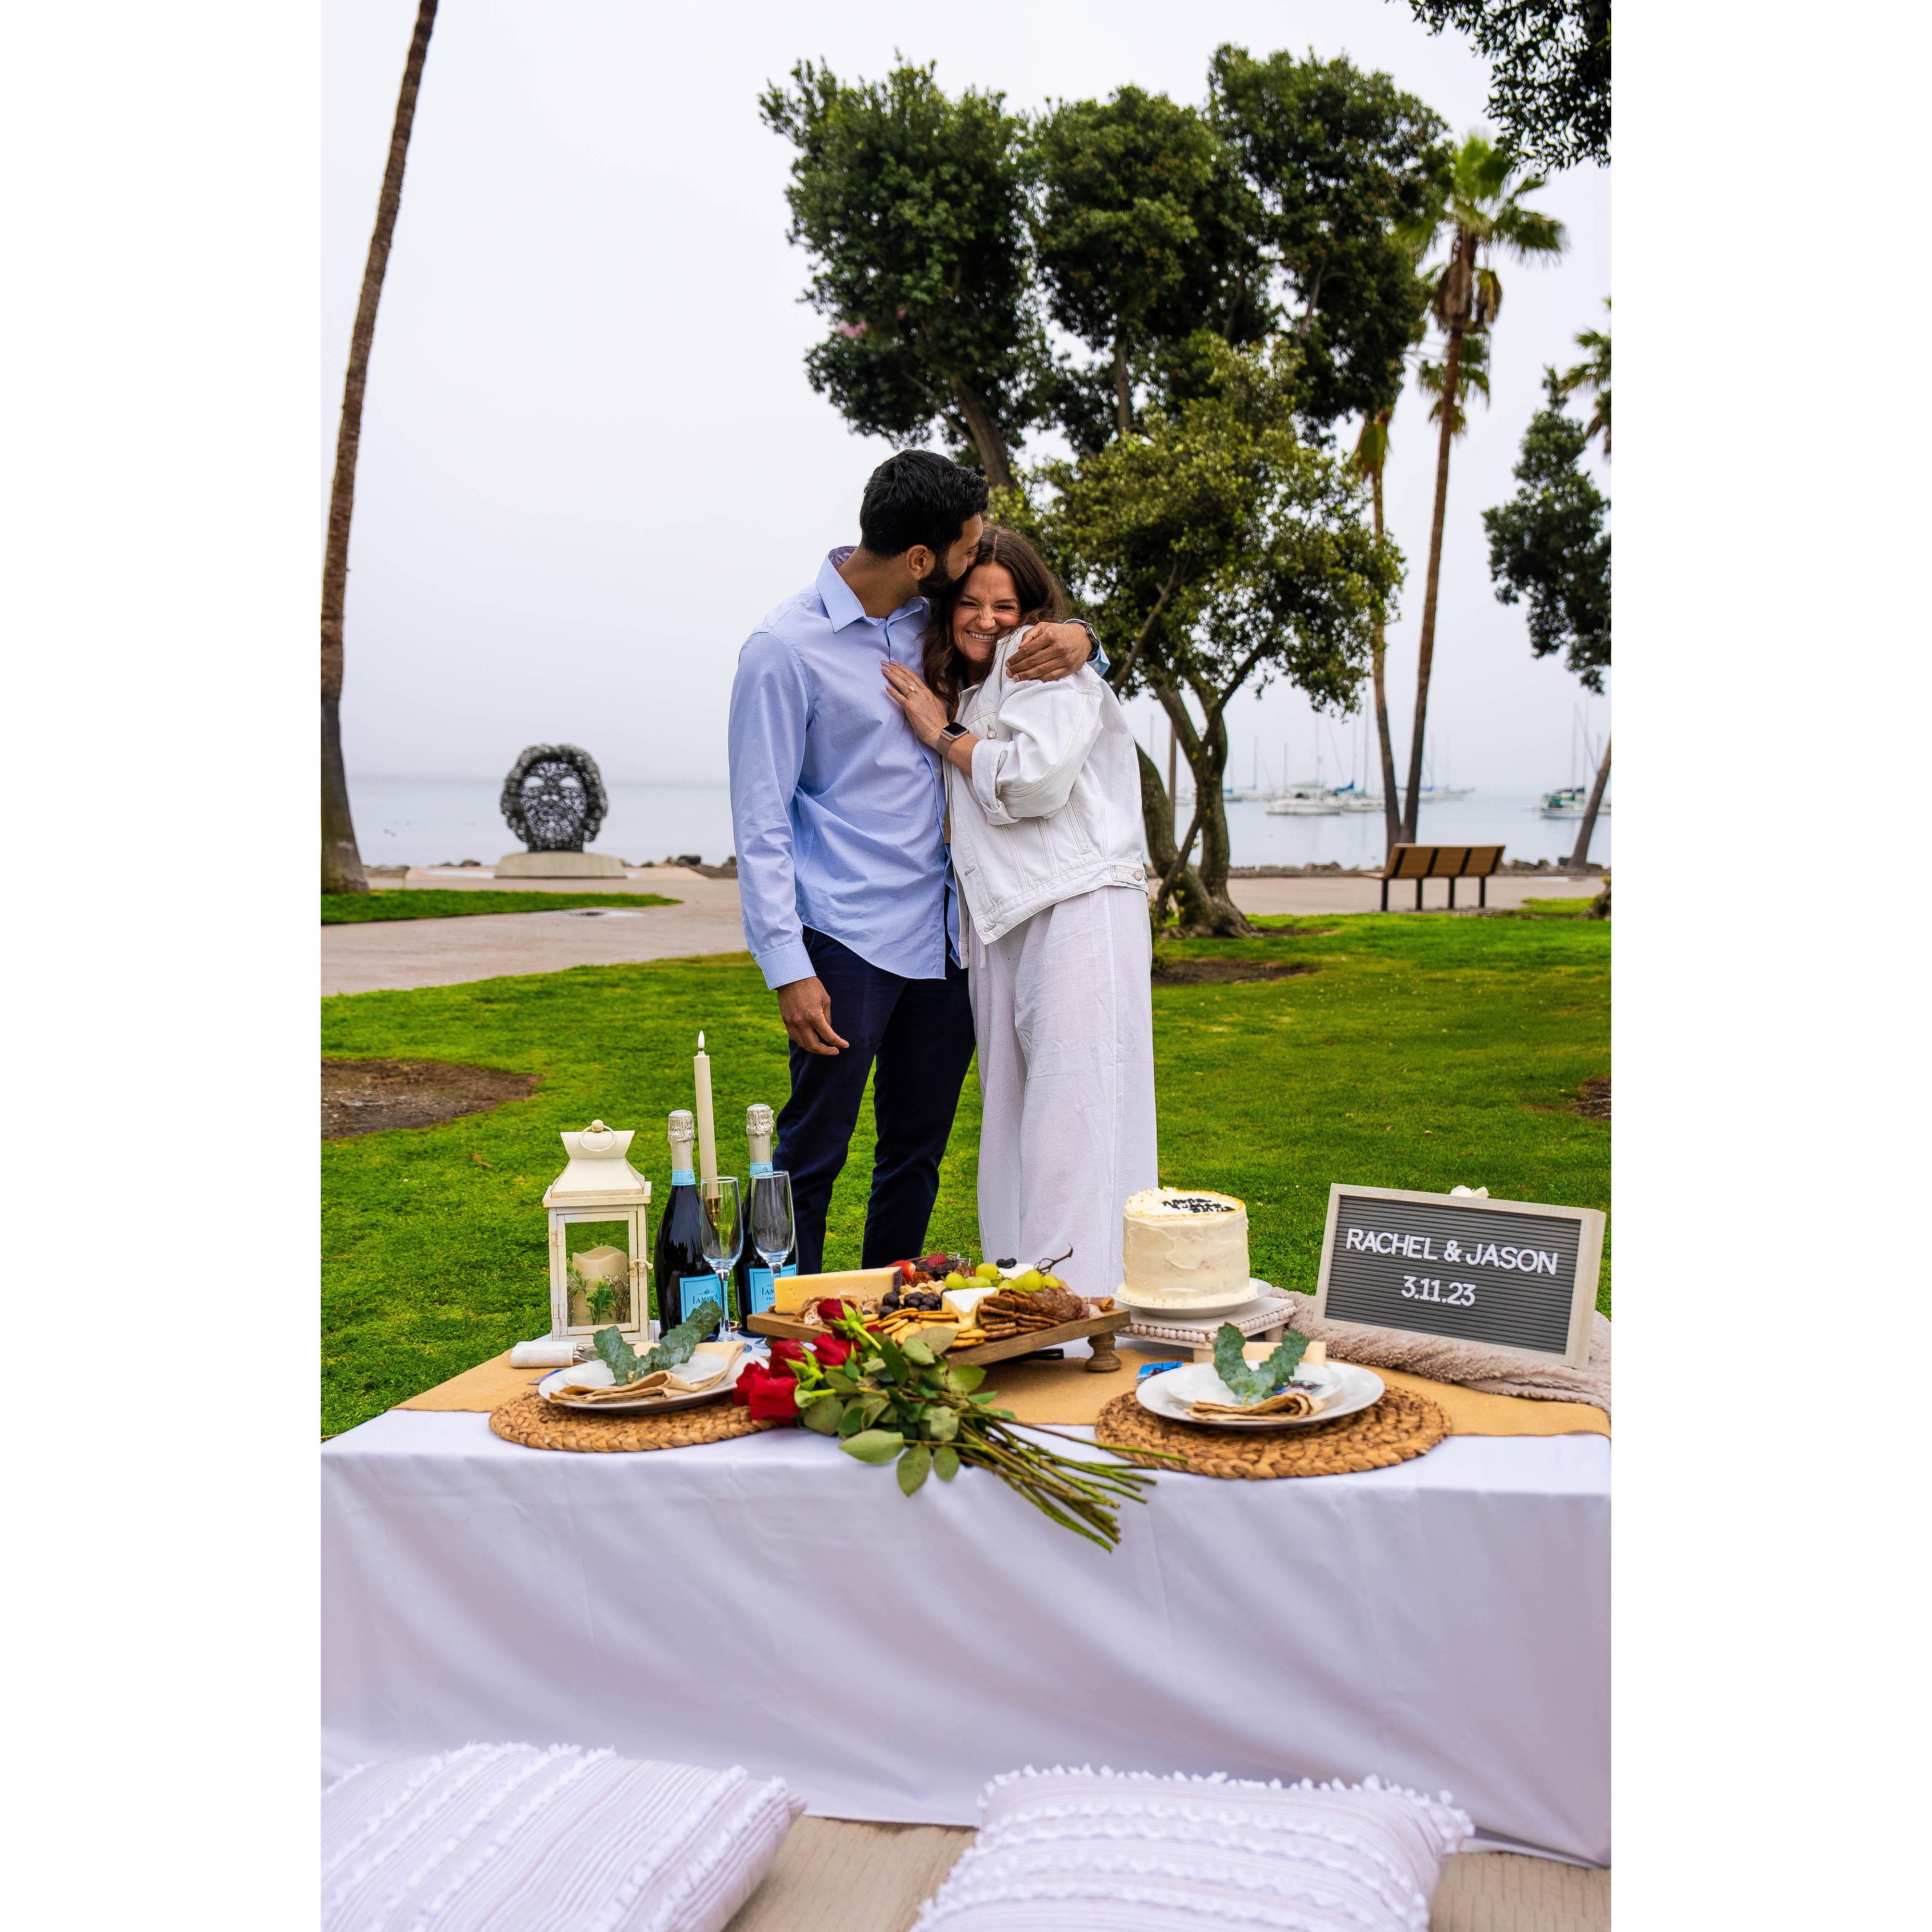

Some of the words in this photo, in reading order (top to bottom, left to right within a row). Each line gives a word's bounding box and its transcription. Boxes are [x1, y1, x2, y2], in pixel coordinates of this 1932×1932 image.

[1345, 1226, 1439, 1261] RACHEL
[1443, 1239, 1463, 1263] &
[1465, 1243, 1559, 1275] JASON
[1400, 1275, 1477, 1307] 3.11.23
